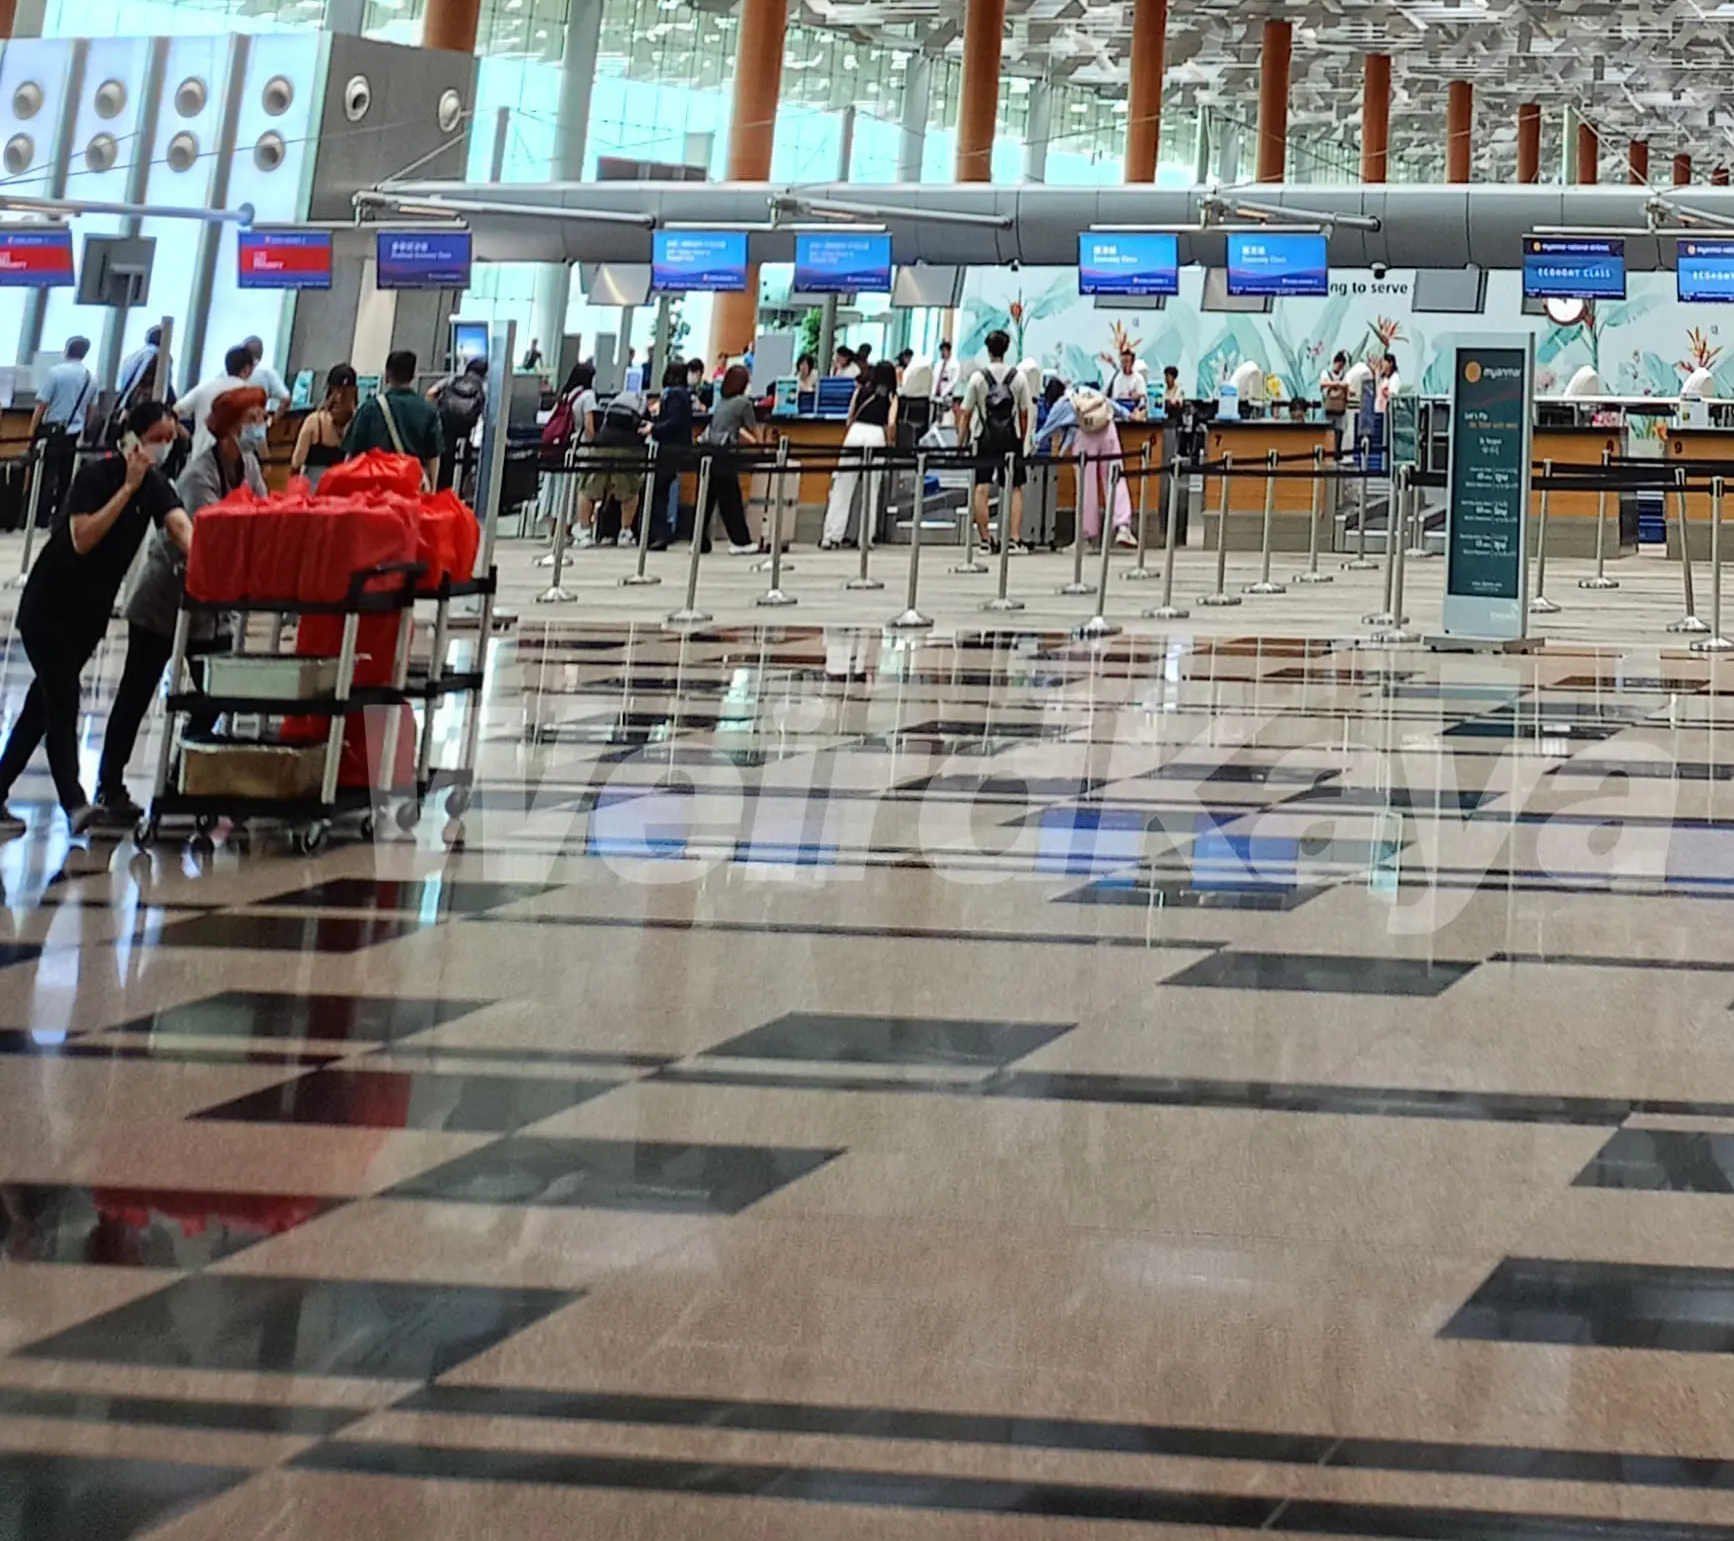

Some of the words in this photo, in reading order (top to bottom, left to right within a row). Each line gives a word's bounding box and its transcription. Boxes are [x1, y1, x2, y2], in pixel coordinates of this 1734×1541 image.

[1583, 267, 1612, 278] CLASS
[1353, 282, 1366, 293] to
[1371, 283, 1408, 294] serve
